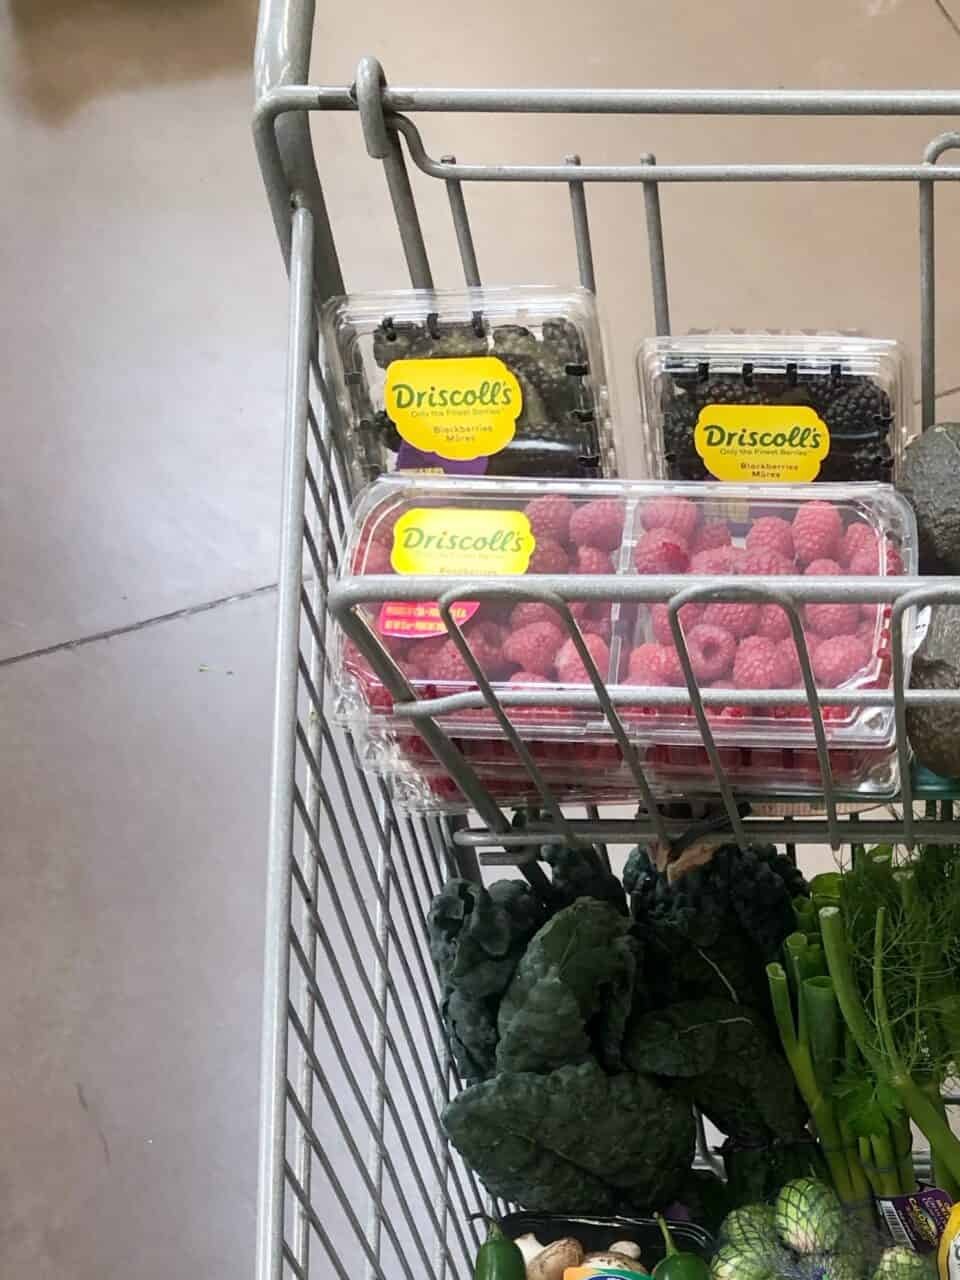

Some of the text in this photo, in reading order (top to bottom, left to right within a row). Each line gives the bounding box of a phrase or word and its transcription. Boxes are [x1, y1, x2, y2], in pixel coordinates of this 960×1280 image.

[391, 381, 512, 409] Driscoll's
[703, 424, 821, 449] Driscoll's
[740, 462, 799, 471] Blackberries
[402, 527, 525, 552] Driscoll's
